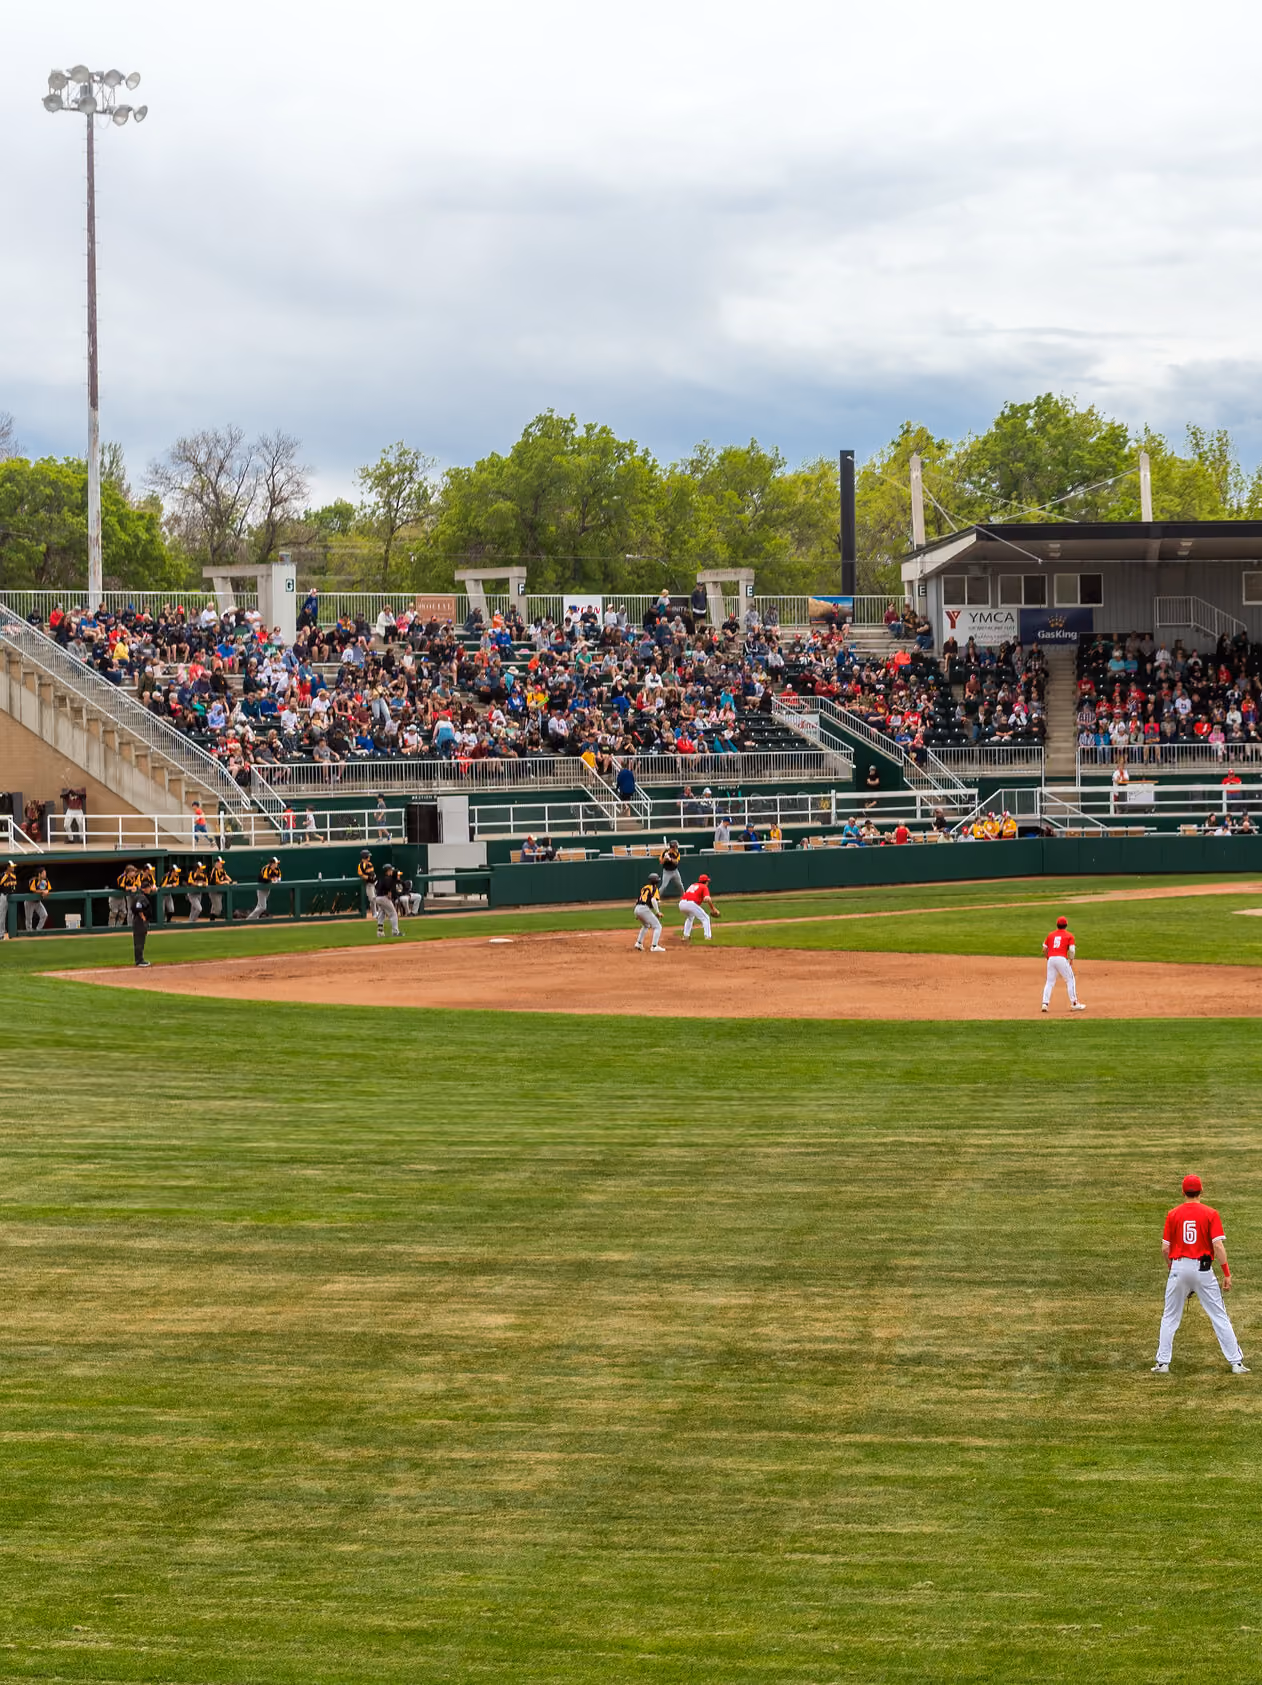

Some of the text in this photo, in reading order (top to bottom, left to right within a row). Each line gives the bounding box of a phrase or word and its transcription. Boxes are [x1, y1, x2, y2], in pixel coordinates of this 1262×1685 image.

[286, 579, 294, 592] G
[518, 584, 525, 595] F
[746, 585, 753, 597] E
[919, 585, 926, 596] E
[968, 611, 1015, 623] YMCA
[1037, 629, 1077, 640] GasKing
[1182, 1220, 1198, 1245] 6
